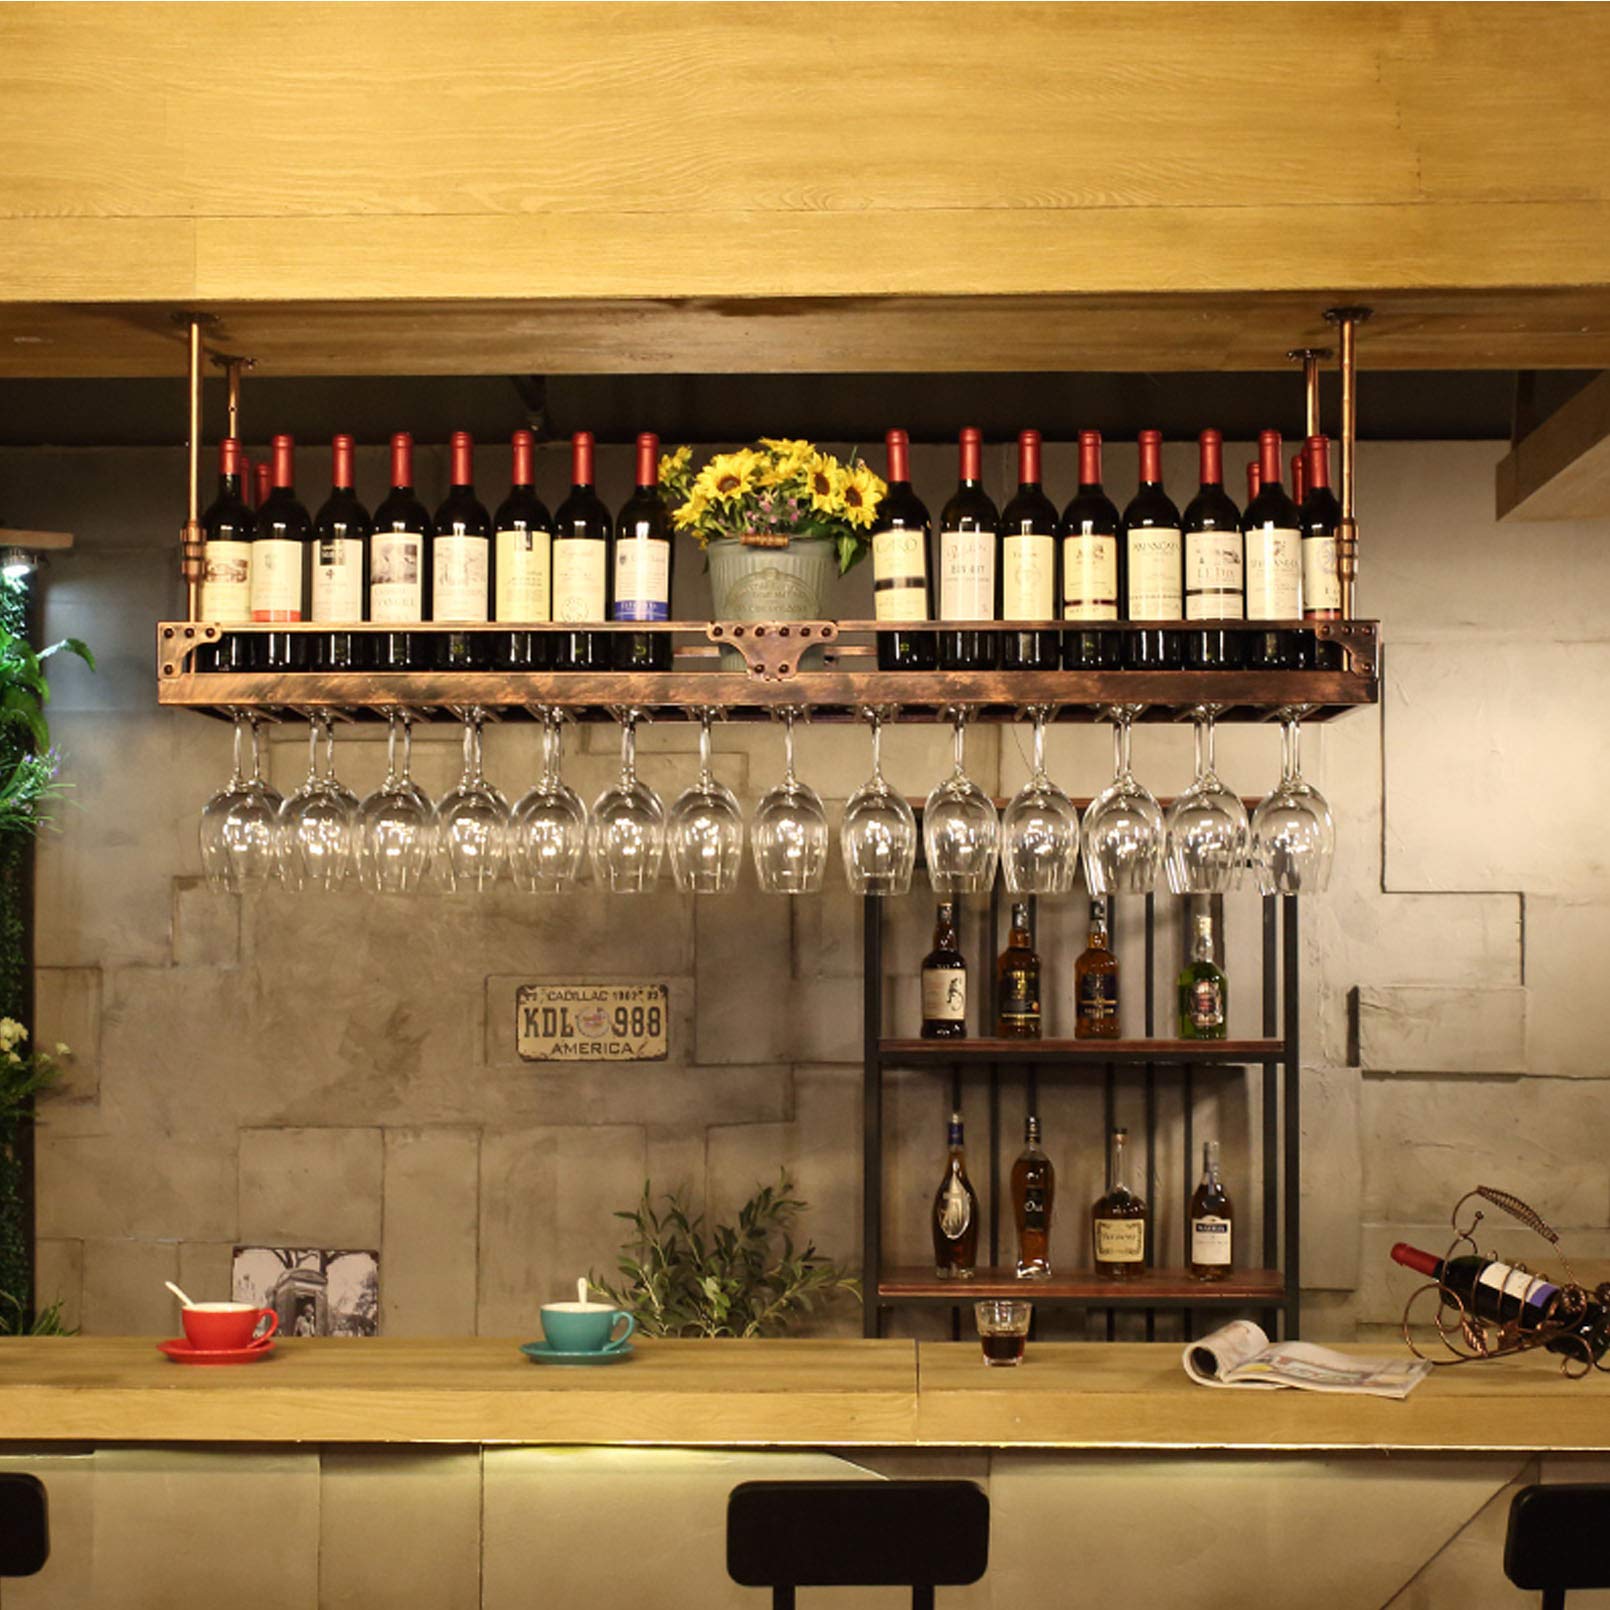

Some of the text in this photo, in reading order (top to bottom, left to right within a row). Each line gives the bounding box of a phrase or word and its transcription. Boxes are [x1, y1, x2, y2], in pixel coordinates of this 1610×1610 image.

[548, 990, 608, 1002] CADILLAC
[524, 1006, 661, 1038] KDL 988
[551, 1042, 633, 1055] AMERICA
